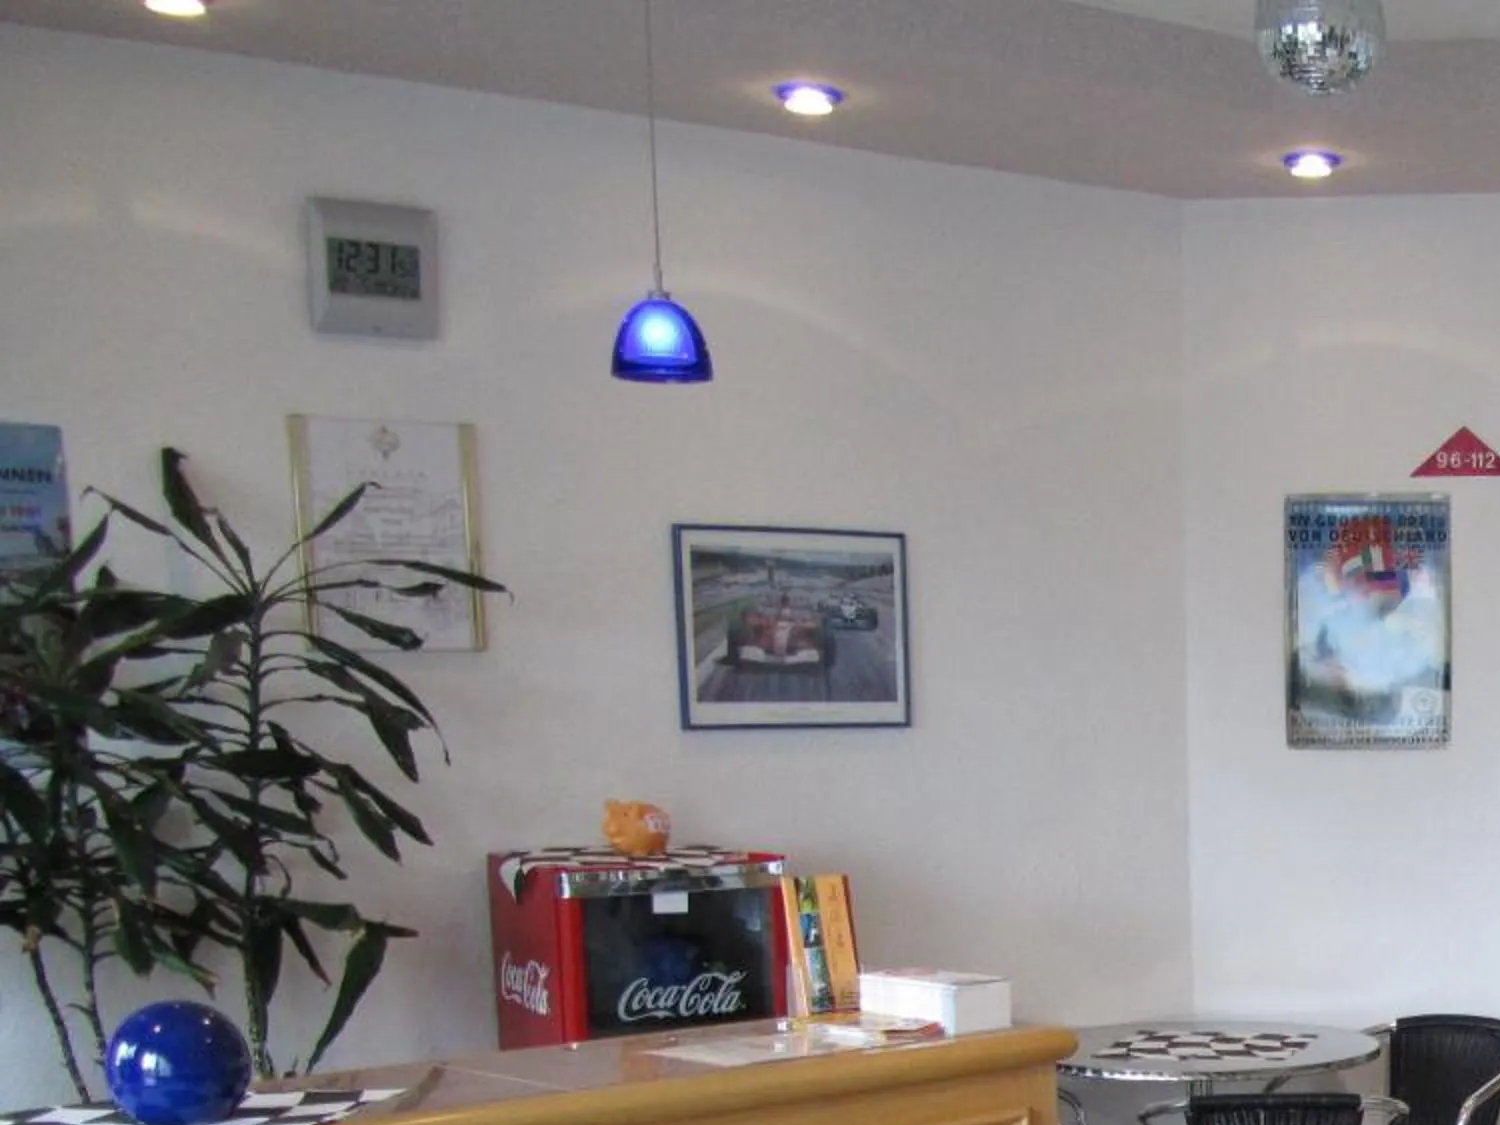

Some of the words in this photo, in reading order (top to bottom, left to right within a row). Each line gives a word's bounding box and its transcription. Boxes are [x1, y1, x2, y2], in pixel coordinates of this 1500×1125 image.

[1436, 451, 1497, 469] 96-112
[1288, 529, 1322, 542] VON
[618, 971, 748, 1022] Coca-Cola
